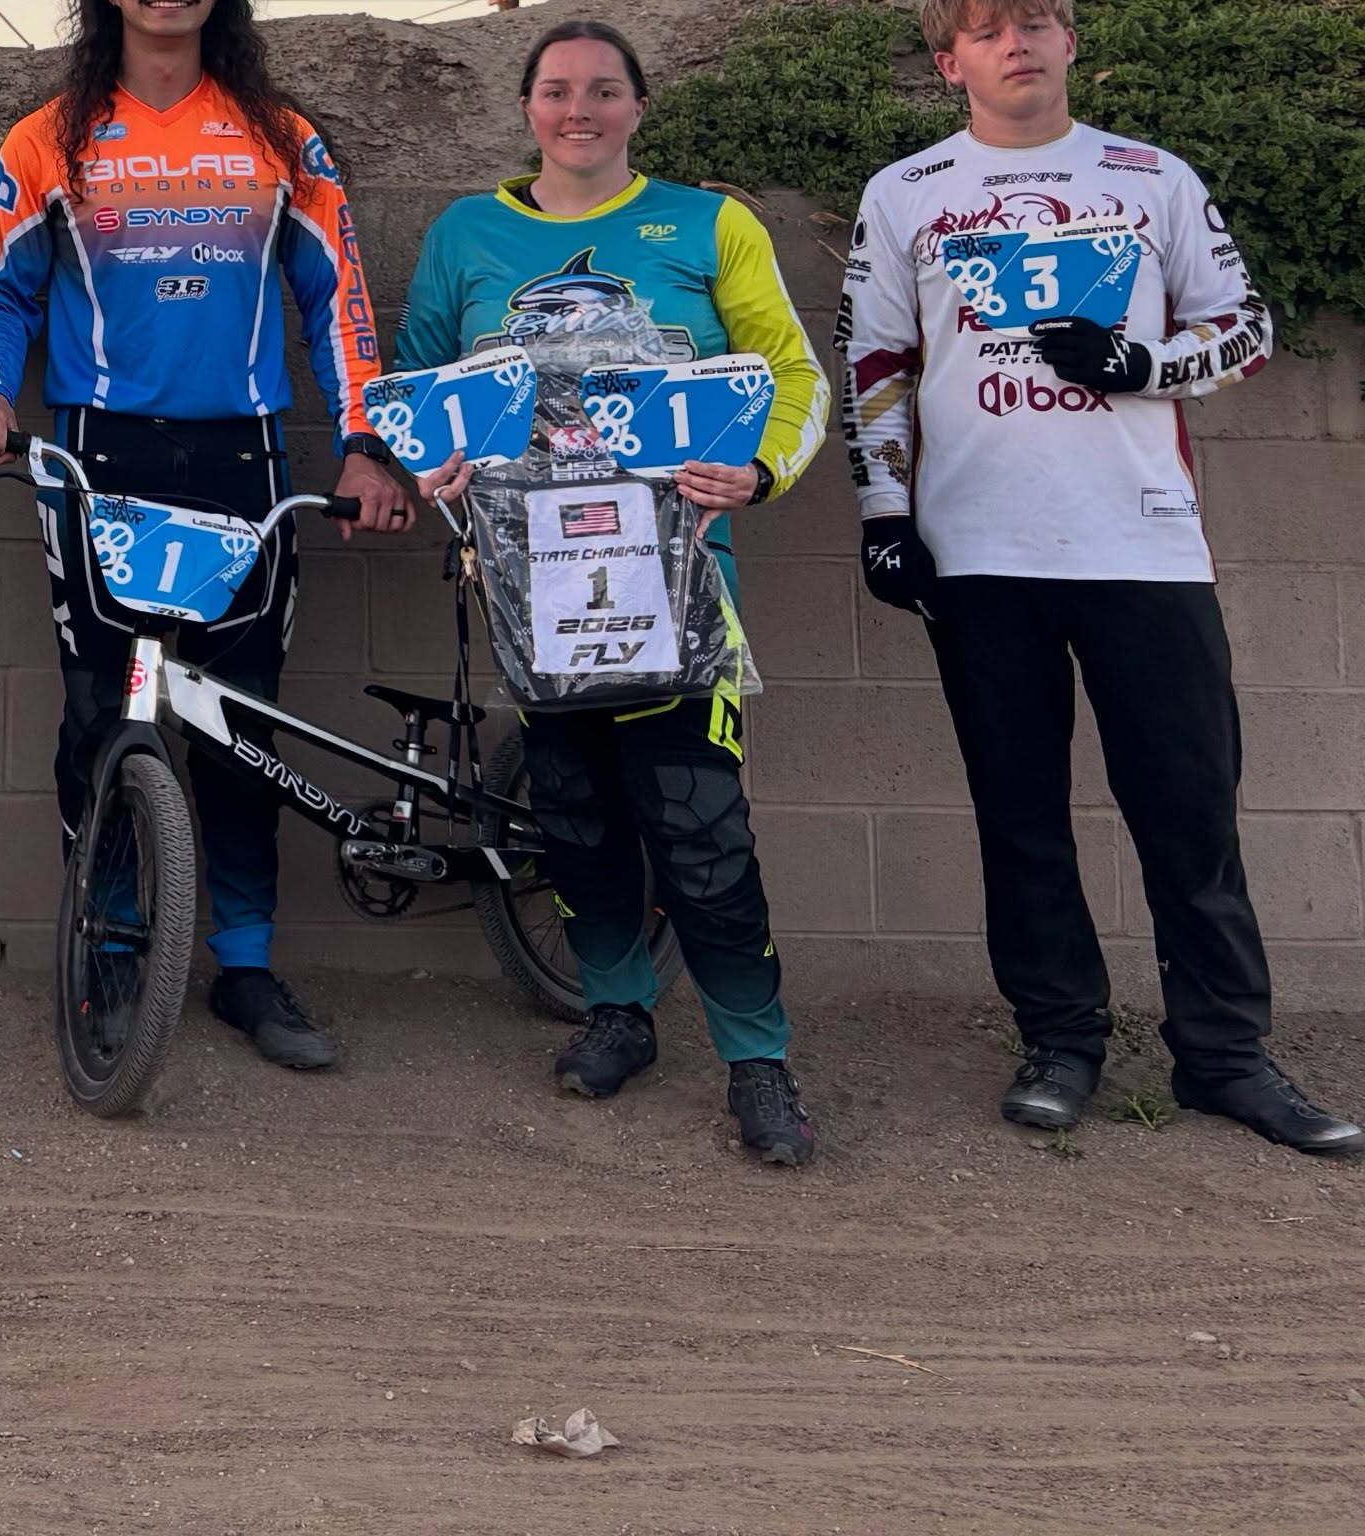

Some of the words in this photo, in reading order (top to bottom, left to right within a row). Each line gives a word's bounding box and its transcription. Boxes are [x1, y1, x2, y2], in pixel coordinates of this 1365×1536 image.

[83, 154, 256, 182] BIOLAB
[1097, 160, 1165, 176] FASTHOUSE
[85, 179, 260, 196] HOLDINGS
[126, 206, 253, 228] SYNDYT
[637, 223, 678, 240] RAD
[107, 245, 184, 261] FLY
[213, 244, 246, 263] box
[945, 241, 1002, 260] CHAMP
[946, 257, 997, 290] 20
[1022, 254, 1060, 311] 3
[1102, 250, 1139, 285] TANGENT
[963, 285, 1008, 317] 26
[365, 383, 417, 407] CHAMP
[507, 374, 536, 416] TANGENT
[585, 377, 642, 396] CHAMP
[1025, 375, 1114, 413] box
[366, 401, 414, 433] 20
[442, 393, 468, 451] 1
[583, 393, 635, 426] 20
[668, 391, 691, 449] 1
[737, 389, 773, 427] TANGENT
[378, 428, 426, 461] 26
[599, 424, 643, 457] 26
[94, 505, 147, 525] CHAMP
[89, 518, 135, 553] 20
[98, 550, 134, 585] 26
[156, 541, 184, 593] 1
[219, 553, 254, 583] TANGENT
[529, 548, 579, 563] STATE
[581, 543, 662, 560] CHAMPION
[586, 566, 615, 610] 1
[148, 604, 190, 618] FLY
[555, 614, 657, 635] 2026
[568, 640, 647, 667] FLY
[232, 732, 370, 836] SYNDYT
